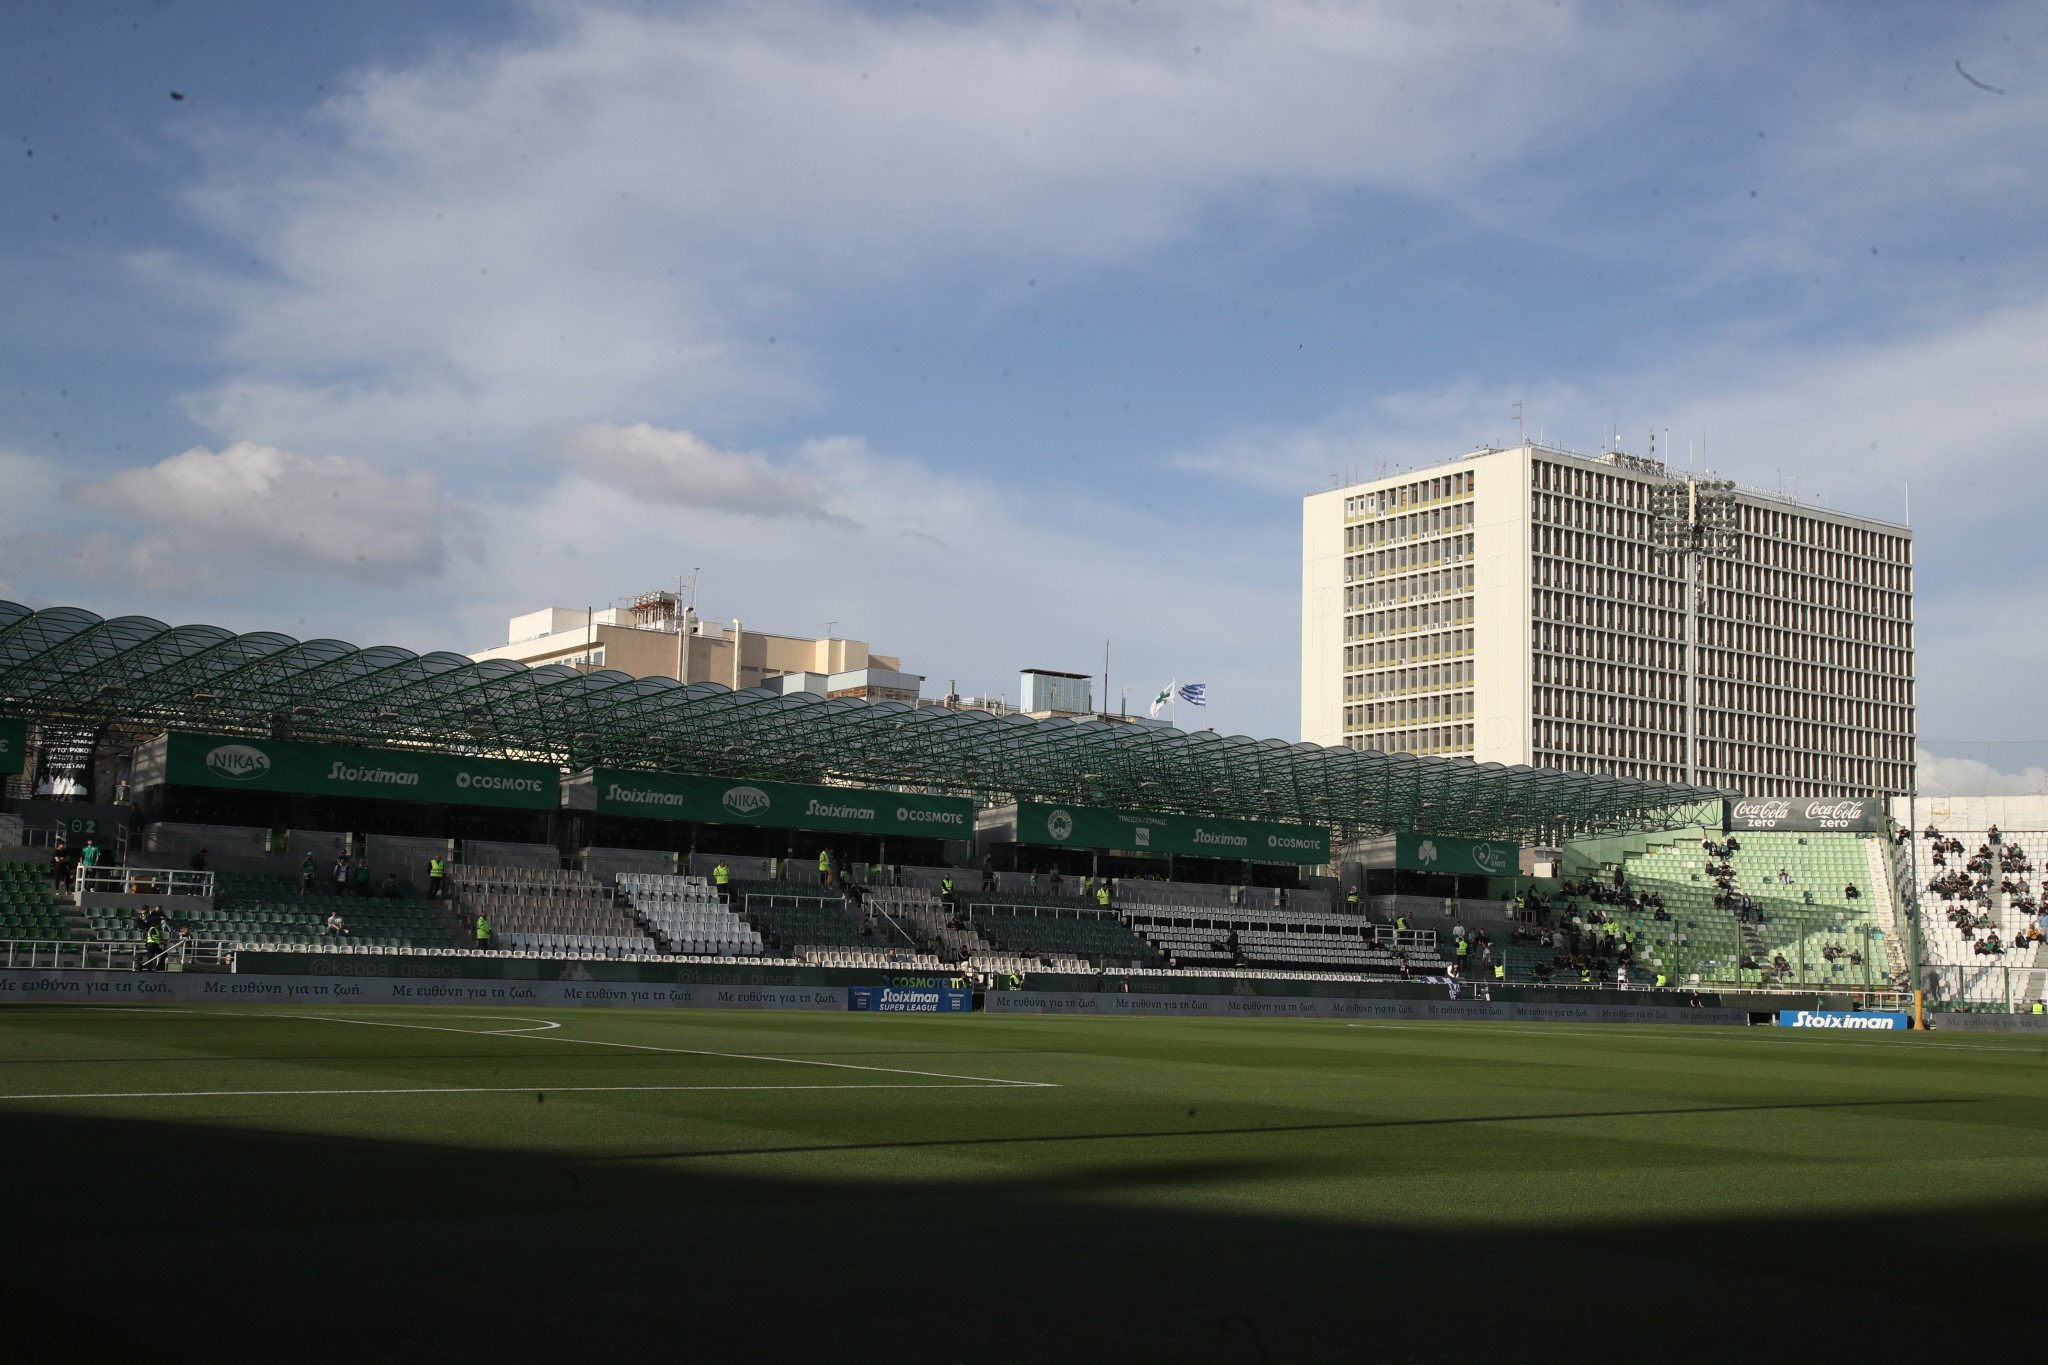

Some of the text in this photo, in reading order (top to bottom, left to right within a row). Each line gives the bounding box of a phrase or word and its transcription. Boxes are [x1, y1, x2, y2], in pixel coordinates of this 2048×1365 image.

[214, 753, 264, 770] NIKAS
[328, 762, 419, 785] Stoiximan
[472, 776, 542, 791] COSMOTE
[605, 784, 684, 805] Stoiximan
[728, 794, 766, 808] NIKAS
[806, 800, 875, 820] Stoiximan
[909, 810, 963, 824] COSMOTE
[1733, 801, 1792, 820] Coca-Cola
[1804, 801, 1865, 820] Coca-Cola
[1747, 819, 1776, 828] zero
[1819, 819, 1849, 828] zero
[1193, 828, 1248, 846] Stoiximan
[1277, 838, 1321, 850] COSMOTE
[22, 979, 80, 992] ευθύνη
[85, 981, 109, 995] για
[115, 982, 132, 994] τη
[137, 980, 171, 995] ζωή.
[204, 981, 364, 997] Με ευθύνη για τη ζωή.
[891, 976, 949, 988] COSMOTE
[392, 985, 536, 1000] Με ευθύνη για τη ζωή.
[563, 988, 582, 999] Με
[586, 988, 627, 1000] ευθύνη
[631, 991, 649, 1003] για
[653, 991, 665, 1002] τη
[718, 991, 735, 1001] Με
[738, 991, 776, 1002] ευθύνη
[779, 993, 796, 1005] για
[799, 994, 811, 1004] τη
[881, 989, 939, 1003] Stoiximan
[880, 1003, 938, 1012] SUPER LEAGUE
[996, 997, 1011, 1007] Με
[1013, 997, 1046, 1008] ευθύνη
[1050, 999, 1063, 1010] για
[1066, 1000, 1076, 1009] τη
[1116, 999, 1130, 1008] Με
[1165, 1001, 1178, 1011] για
[1180, 1001, 1189, 1010] τη
[1792, 1011, 1894, 1029] Stoiximan
